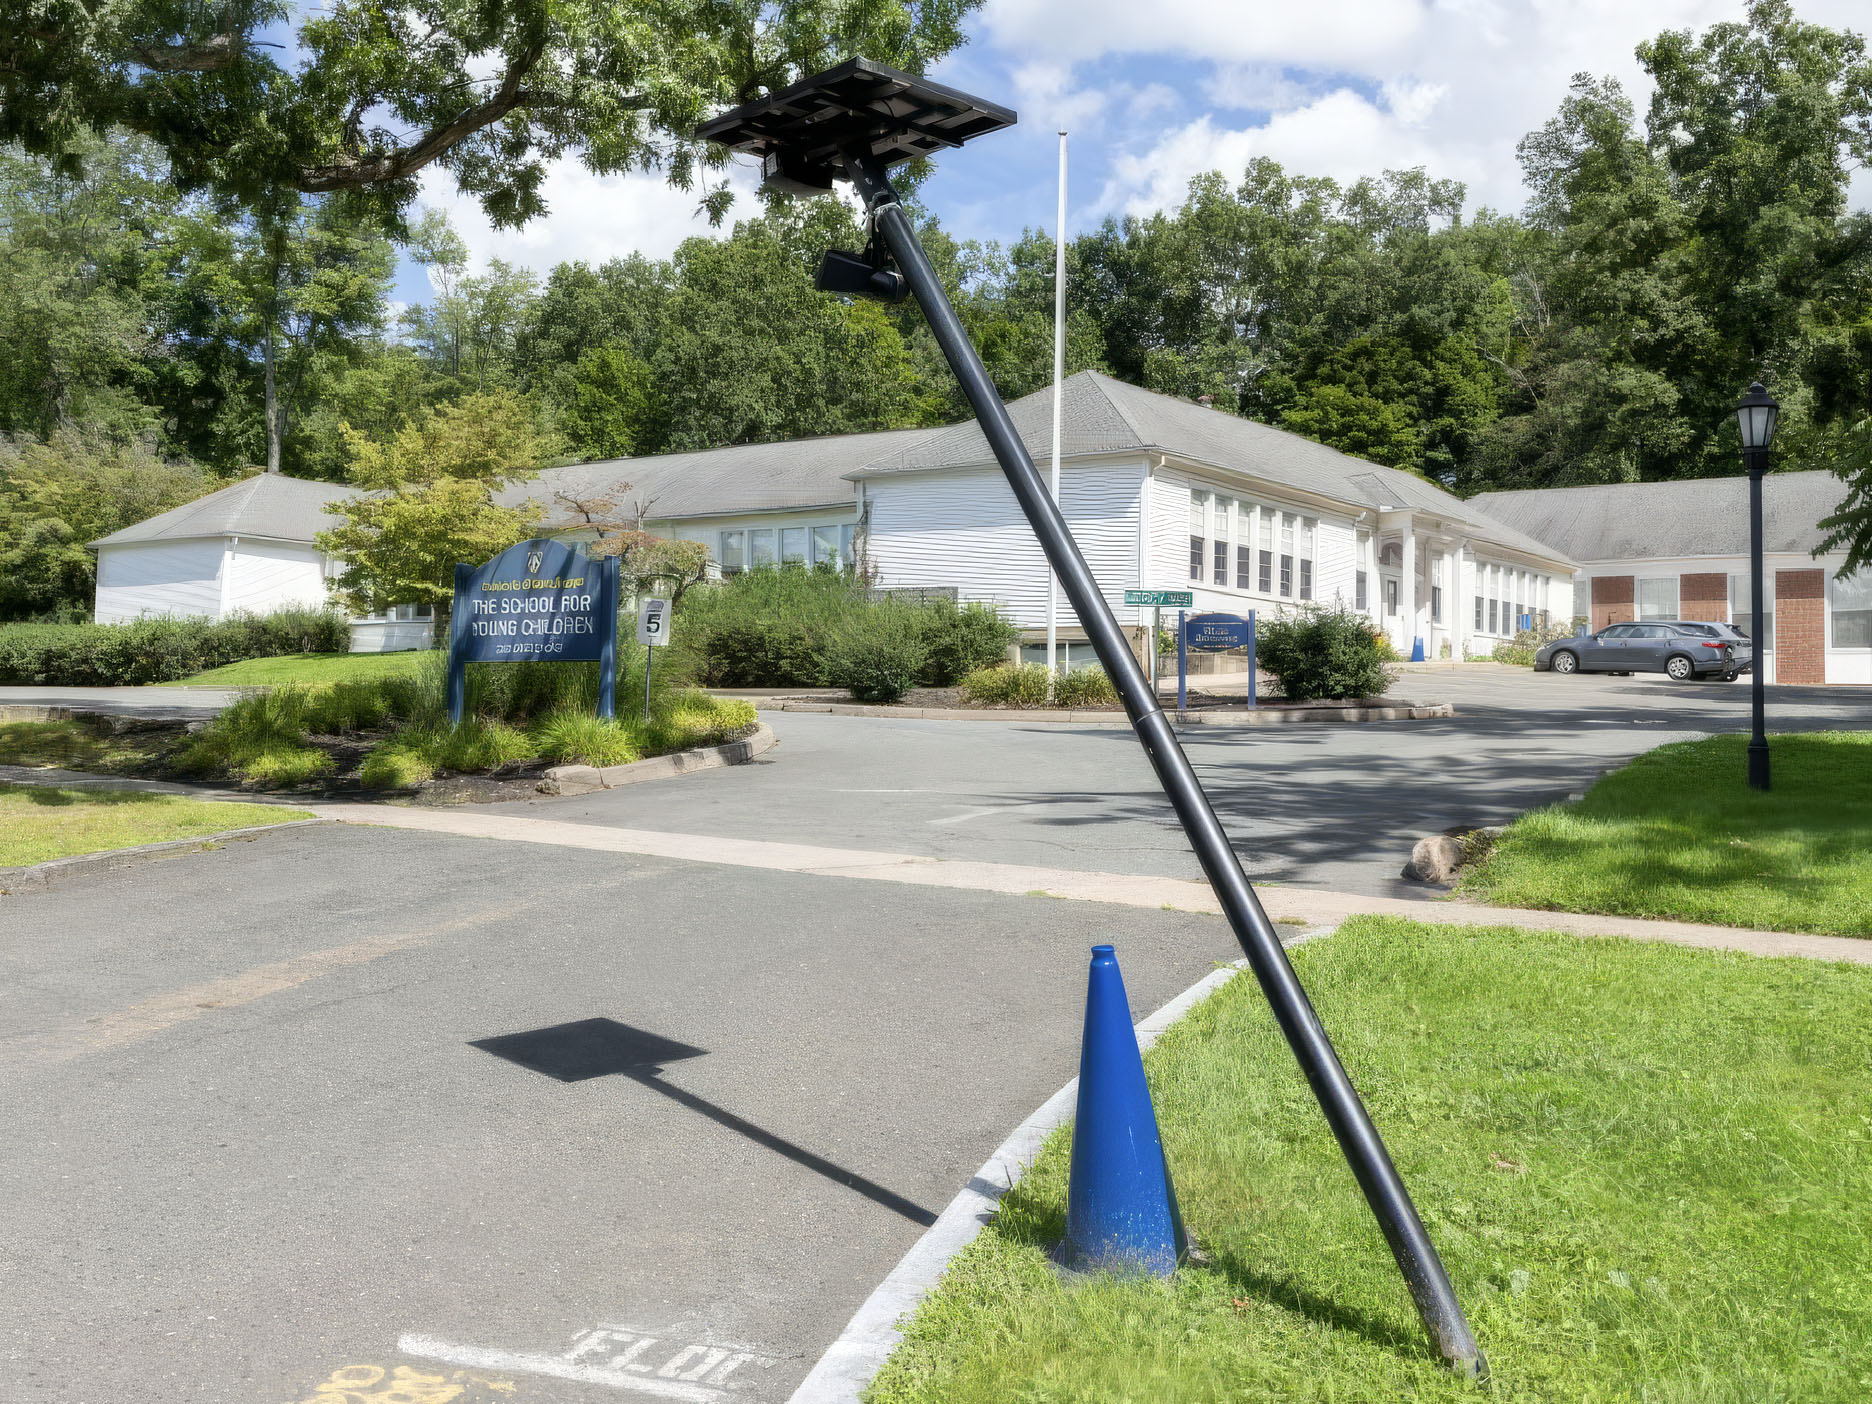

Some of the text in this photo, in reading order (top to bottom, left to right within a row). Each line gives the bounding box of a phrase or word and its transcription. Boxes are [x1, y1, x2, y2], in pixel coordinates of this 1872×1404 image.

[472, 595, 591, 615] THE SCHOOL FOR
[646, 614, 662, 633] 5
